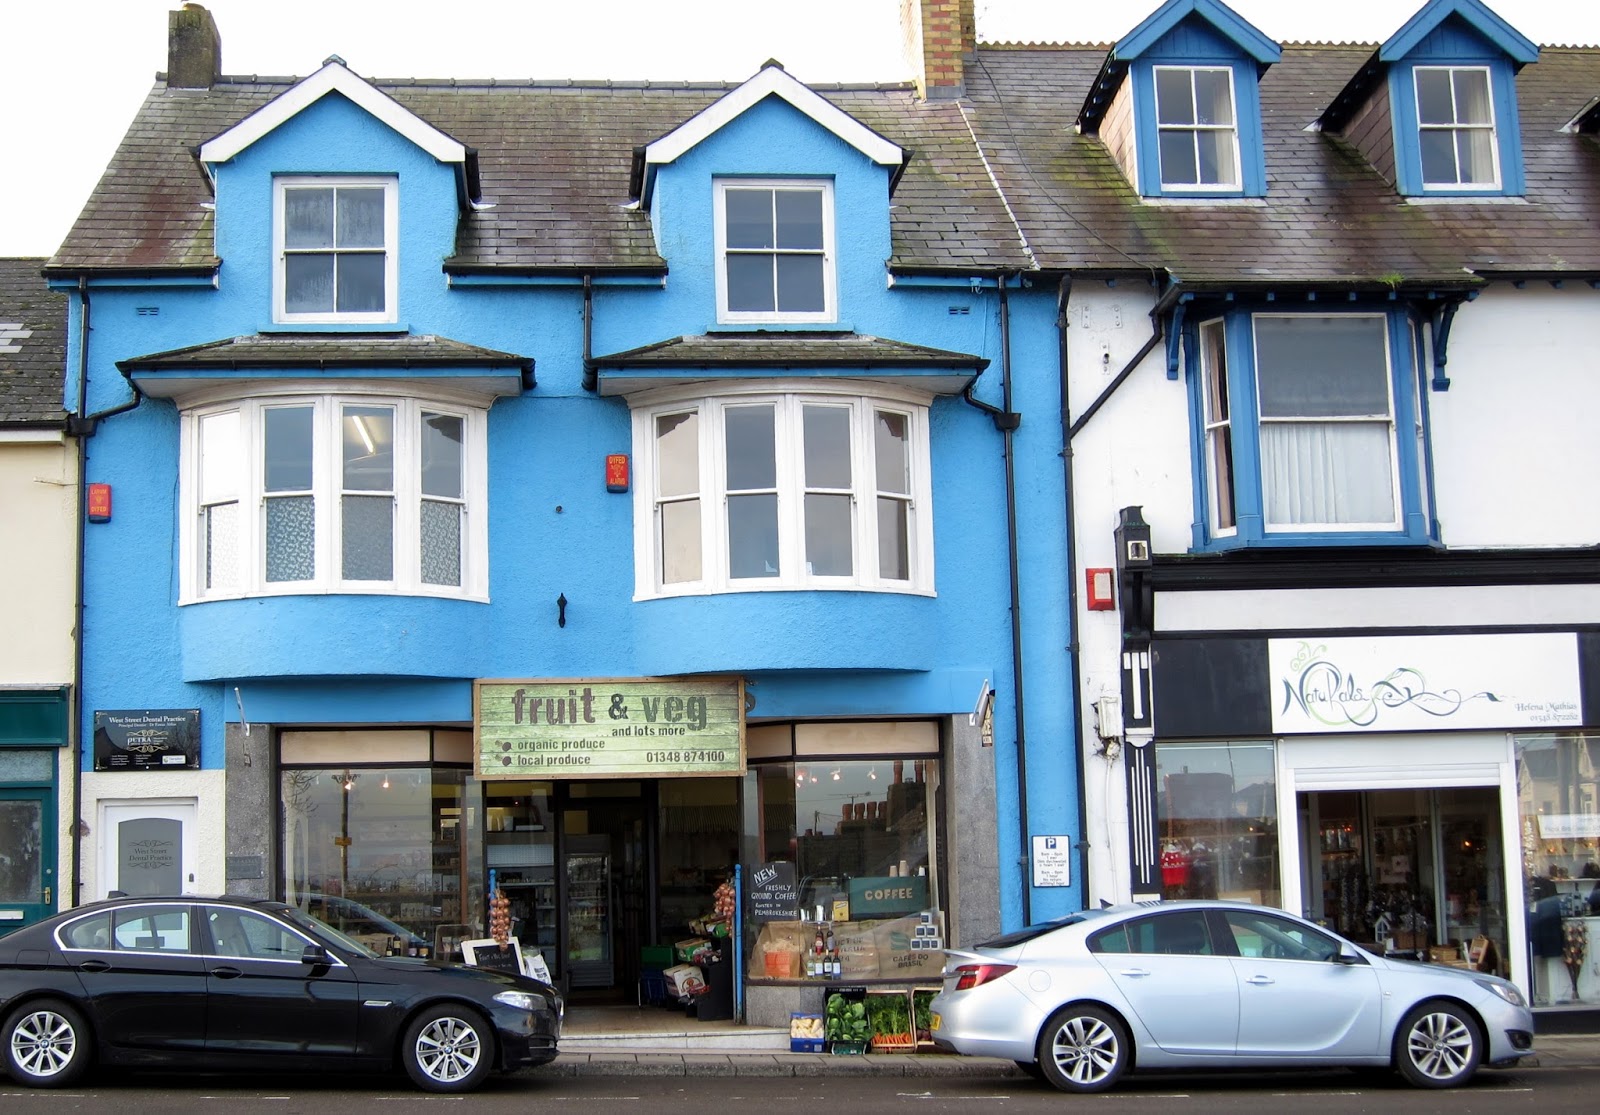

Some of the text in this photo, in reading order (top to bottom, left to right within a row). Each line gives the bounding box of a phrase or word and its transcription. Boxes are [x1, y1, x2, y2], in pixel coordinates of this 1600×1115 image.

[511, 687, 707, 731] fruit & veg
[1515, 702, 1544, 712] Helena
[108, 716, 124, 724] West
[612, 725, 686, 736] and lots more
[518, 738, 606, 752] organic produce
[518, 754, 591, 767] local produce
[646, 750, 725, 764] 01348 874100
[754, 865, 778, 884] NEW
[765, 884, 792, 892] FRESHLY
[751, 892, 772, 900] GROUND
[864, 888, 913, 901] COFFEE
[898, 961, 922, 969] BRASIL
